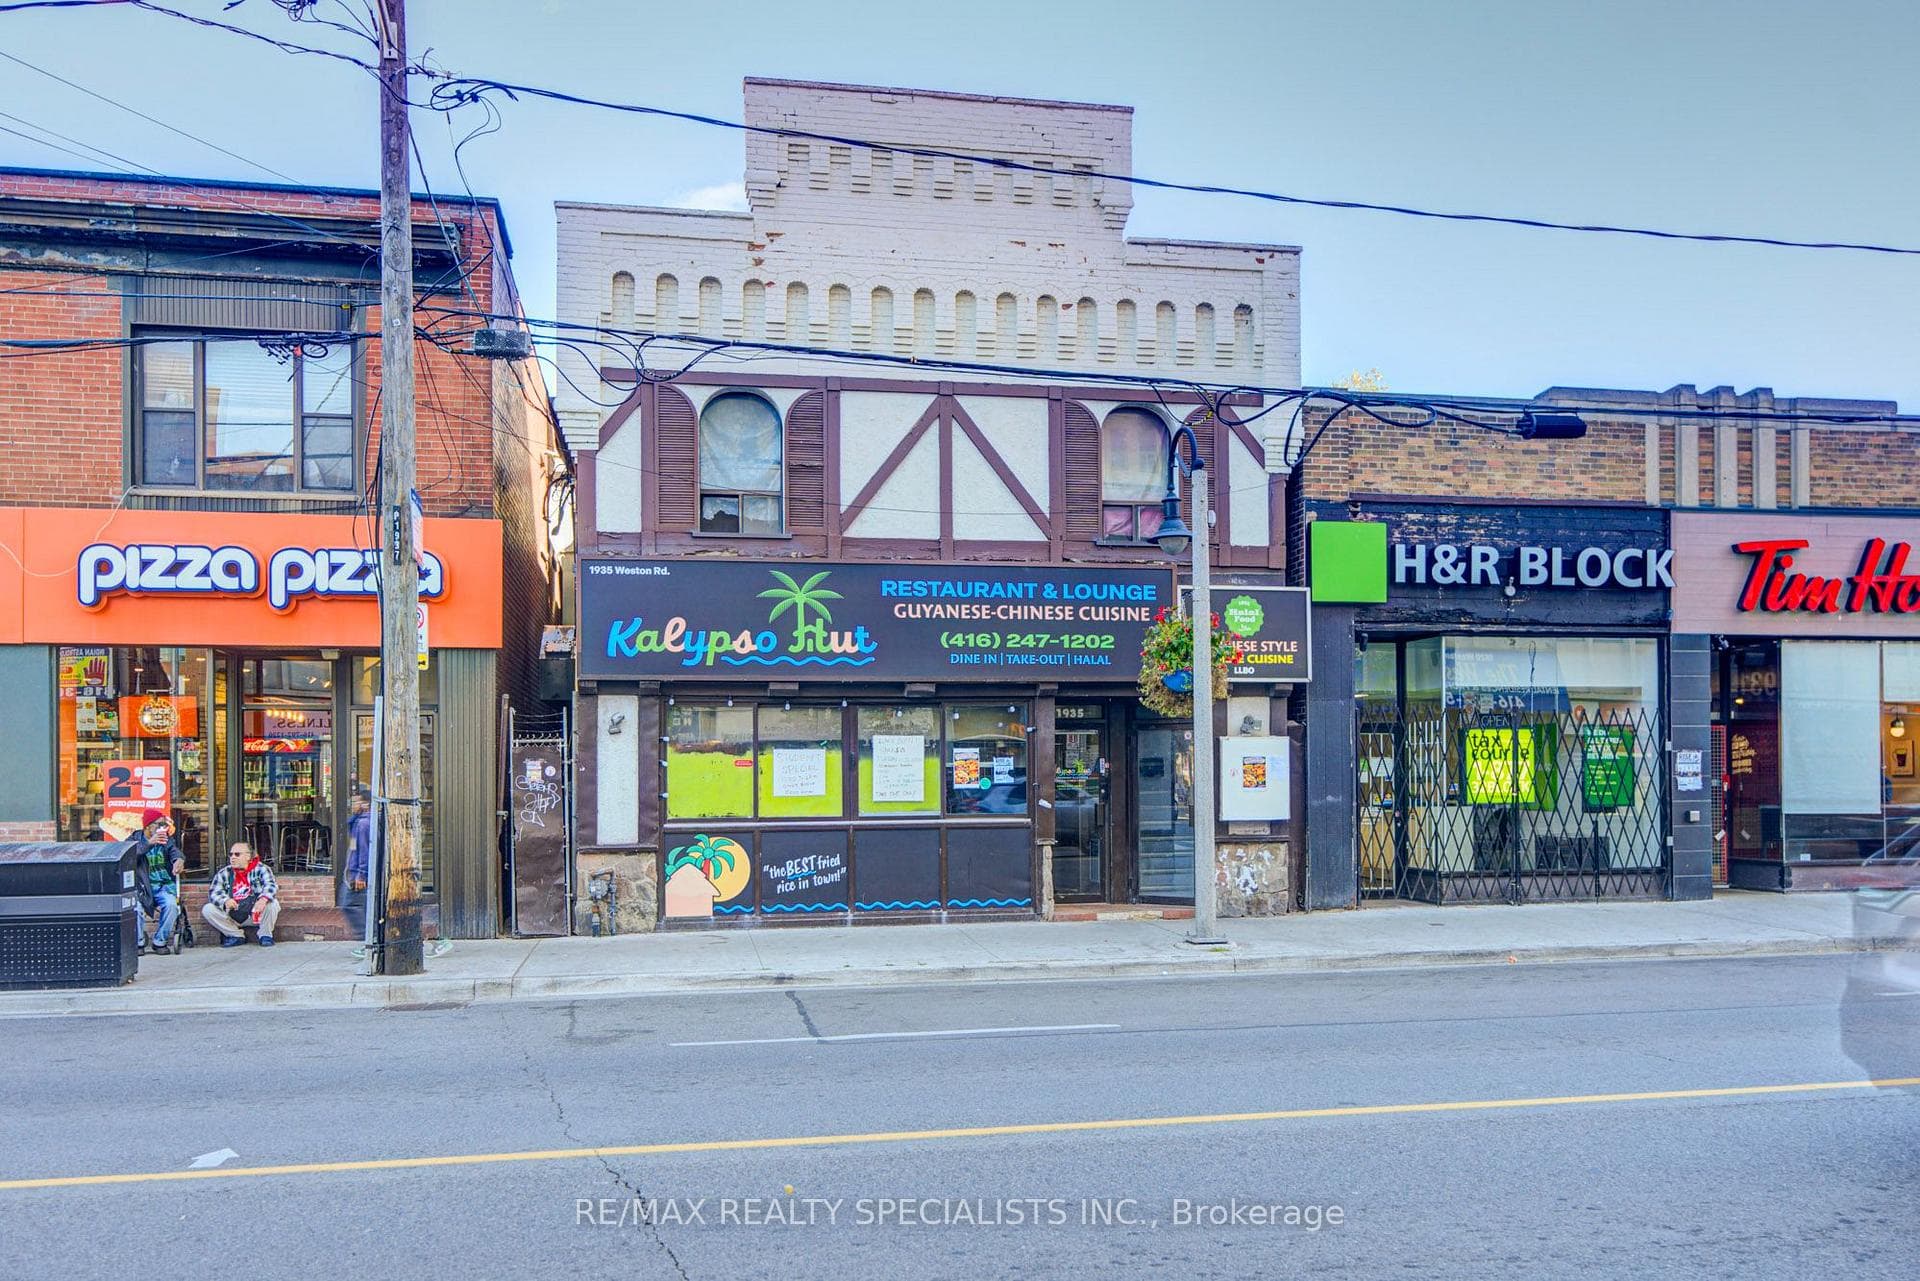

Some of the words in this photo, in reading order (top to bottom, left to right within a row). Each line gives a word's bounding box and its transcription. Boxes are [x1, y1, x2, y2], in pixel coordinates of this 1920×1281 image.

[77, 543, 258, 606] pizza
[589, 565, 613, 575] 1935
[615, 566, 652, 576] Weston
[653, 567, 671, 576] Rd.
[1394, 544, 1500, 585] H&R
[1520, 547, 1675, 588] BLOCK
[1732, 539, 1842, 612] Tim
[881, 580, 1038, 600] RESTAURANT
[1042, 583, 1058, 600] &
[1063, 584, 1157, 601] LOUNGE
[894, 603, 1074, 621] GUYANESE-CHINESE
[1079, 606, 1150, 622] CUISINE
[607, 617, 778, 666] Kalypso
[940, 632, 1001, 649] (416)
[1006, 633, 1115, 649] 247-1202
[1261, 641, 1298, 652] STYLE
[950, 653, 980, 664] DINE
[983, 654, 997, 665] IN
[1006, 654, 1065, 665] TAKE-OUT
[1074, 655, 1111, 665] HALAL
[1247, 655, 1294, 664] CUISINE
[1056, 709, 1084, 718] 1935
[1472, 734, 1502, 747] tax
[109, 767, 131, 798] 2
[785, 855, 817, 876] BEST
[817, 854, 840, 869] fried
[777, 879, 796, 894] rice
[799, 877, 809, 889] in
